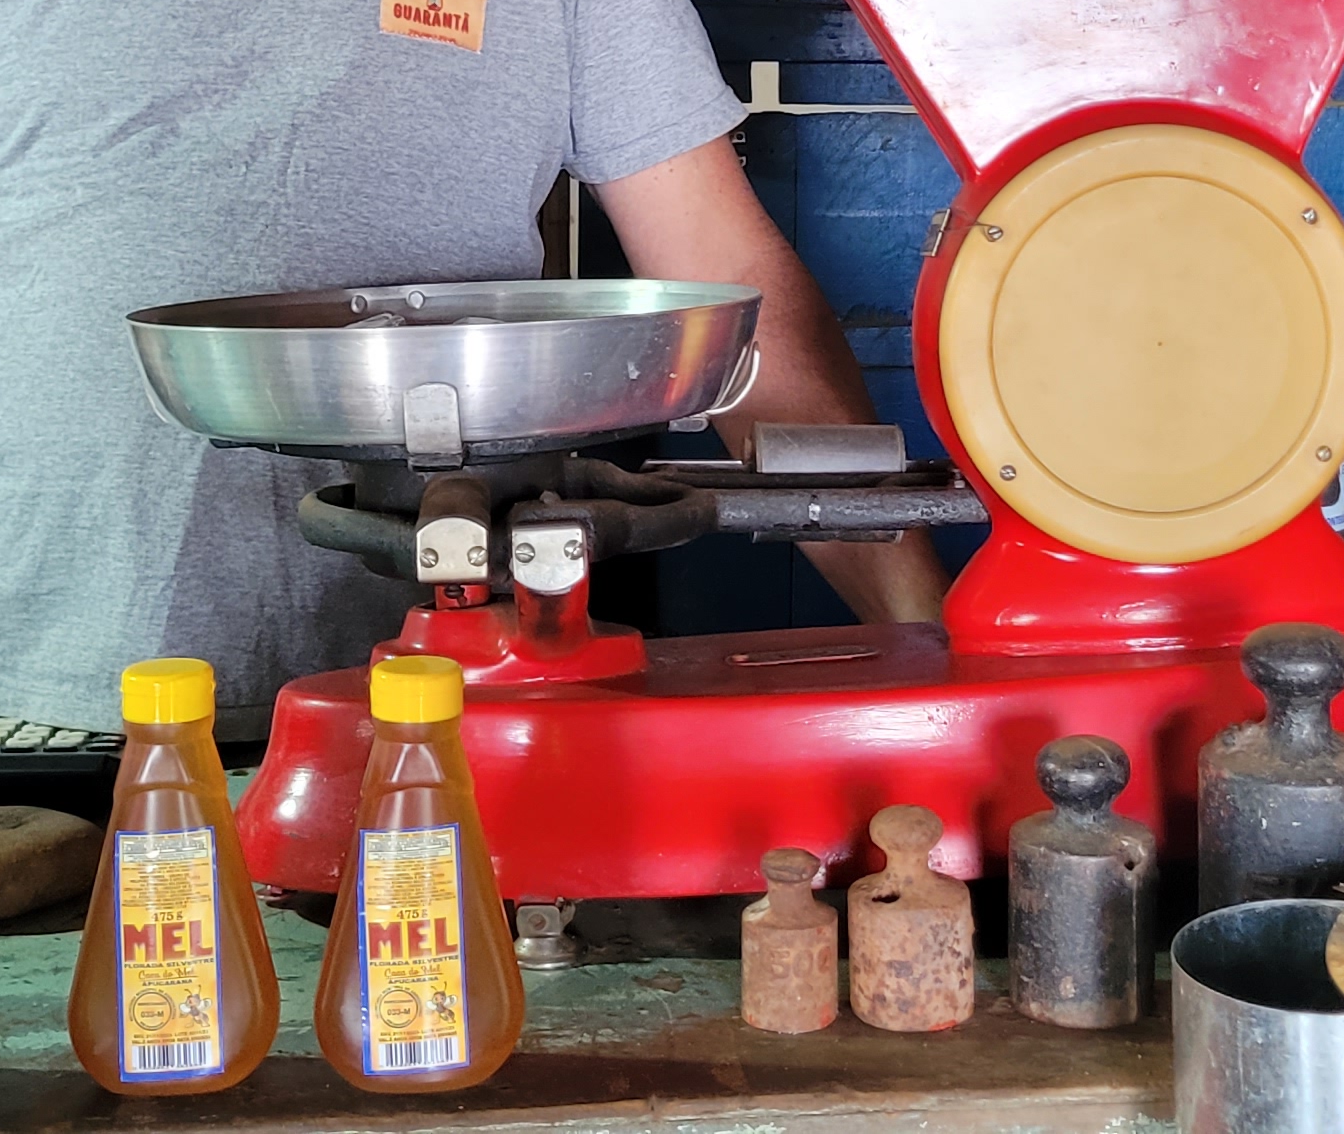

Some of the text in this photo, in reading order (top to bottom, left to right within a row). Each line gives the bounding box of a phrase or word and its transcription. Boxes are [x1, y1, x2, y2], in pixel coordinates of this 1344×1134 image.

[150, 911, 184, 923] 475 g
[396, 908, 429, 921] 475 g
[122, 919, 214, 964] MEL
[367, 916, 459, 961] MEL
[124, 957, 215, 970] FLORADA SILVESTRE
[369, 954, 459, 967] FLORADA SILVESTRE
